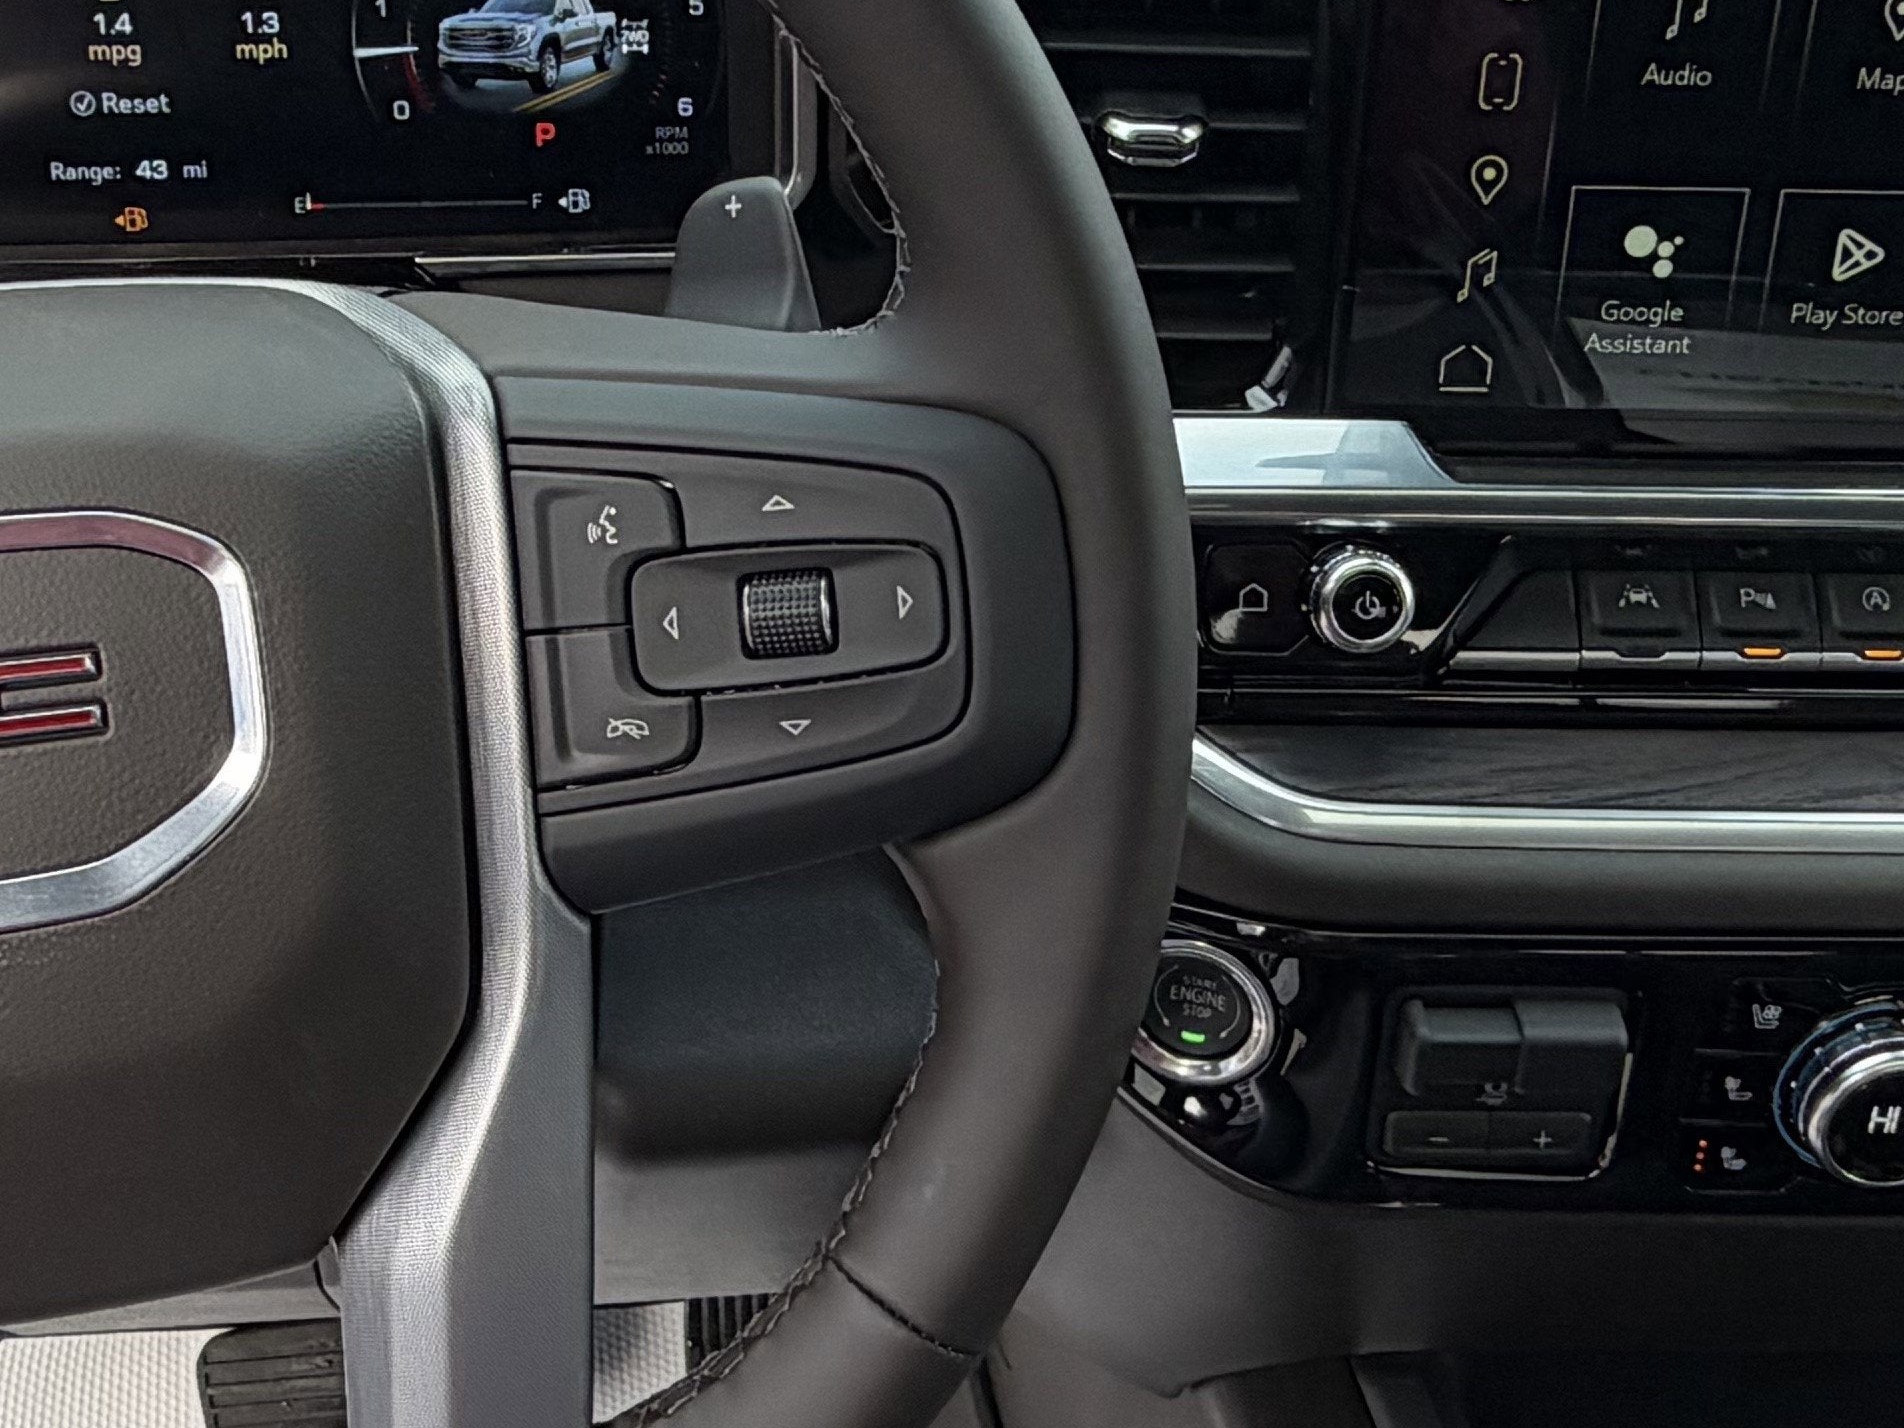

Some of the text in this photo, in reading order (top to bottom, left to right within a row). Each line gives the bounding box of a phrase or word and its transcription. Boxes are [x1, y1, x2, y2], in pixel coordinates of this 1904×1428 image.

[92, 13, 133, 37] 1.4
[240, 11, 280, 35] 1.3
[88, 40, 143, 67] mpg
[235, 38, 289, 63] mph
[1641, 62, 1713, 87] Audio
[101, 92, 171, 115] Reset
[394, 99, 410, 121] 0
[677, 96, 694, 117] 6
[534, 122, 555, 145] P
[50, 159, 208, 187] Range: 43 mi
[1601, 300, 1684, 325] Google
[1790, 303, 1904, 329] Play Store
[1584, 333, 1691, 356] Assistant
[1169, 984, 1226, 1012] ENGINE
[1868, 1105, 1903, 1135] HI
